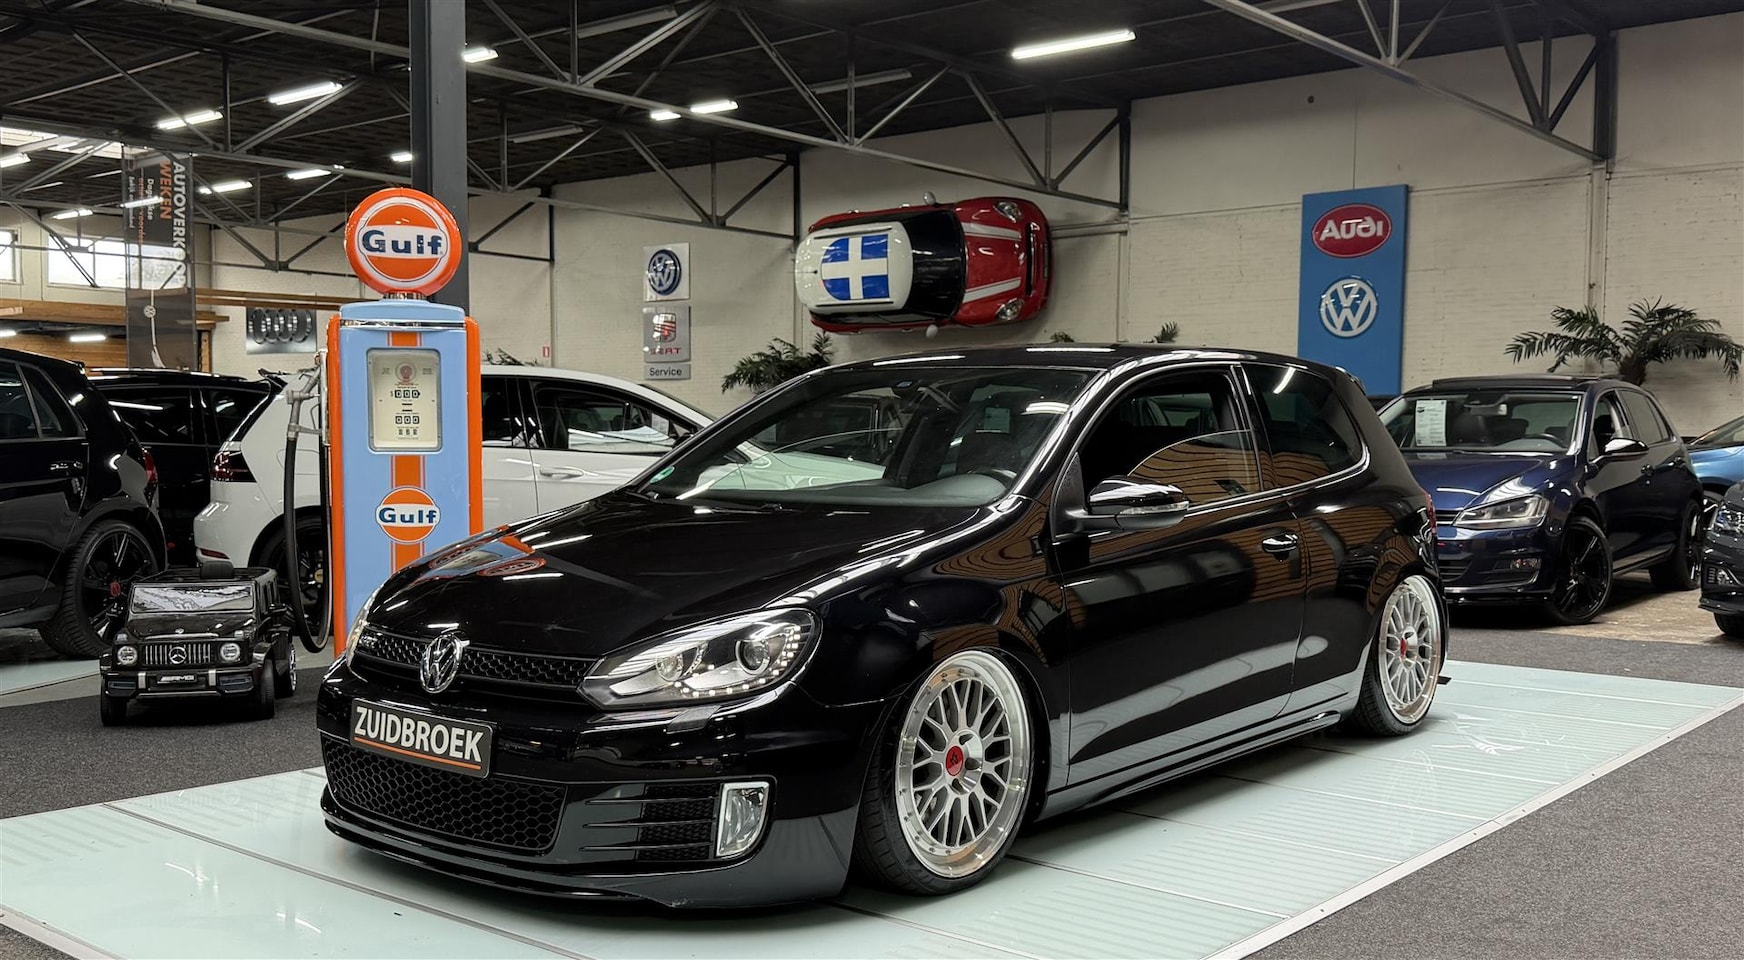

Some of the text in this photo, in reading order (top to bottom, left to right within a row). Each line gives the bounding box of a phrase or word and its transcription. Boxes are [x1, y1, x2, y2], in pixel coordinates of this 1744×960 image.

[160, 160, 172, 219] WEKEN
[362, 229, 442, 255] Gulf
[650, 367, 682, 377] Service
[379, 507, 437, 524] Gulf
[354, 706, 483, 763] ZUIDBROEK
